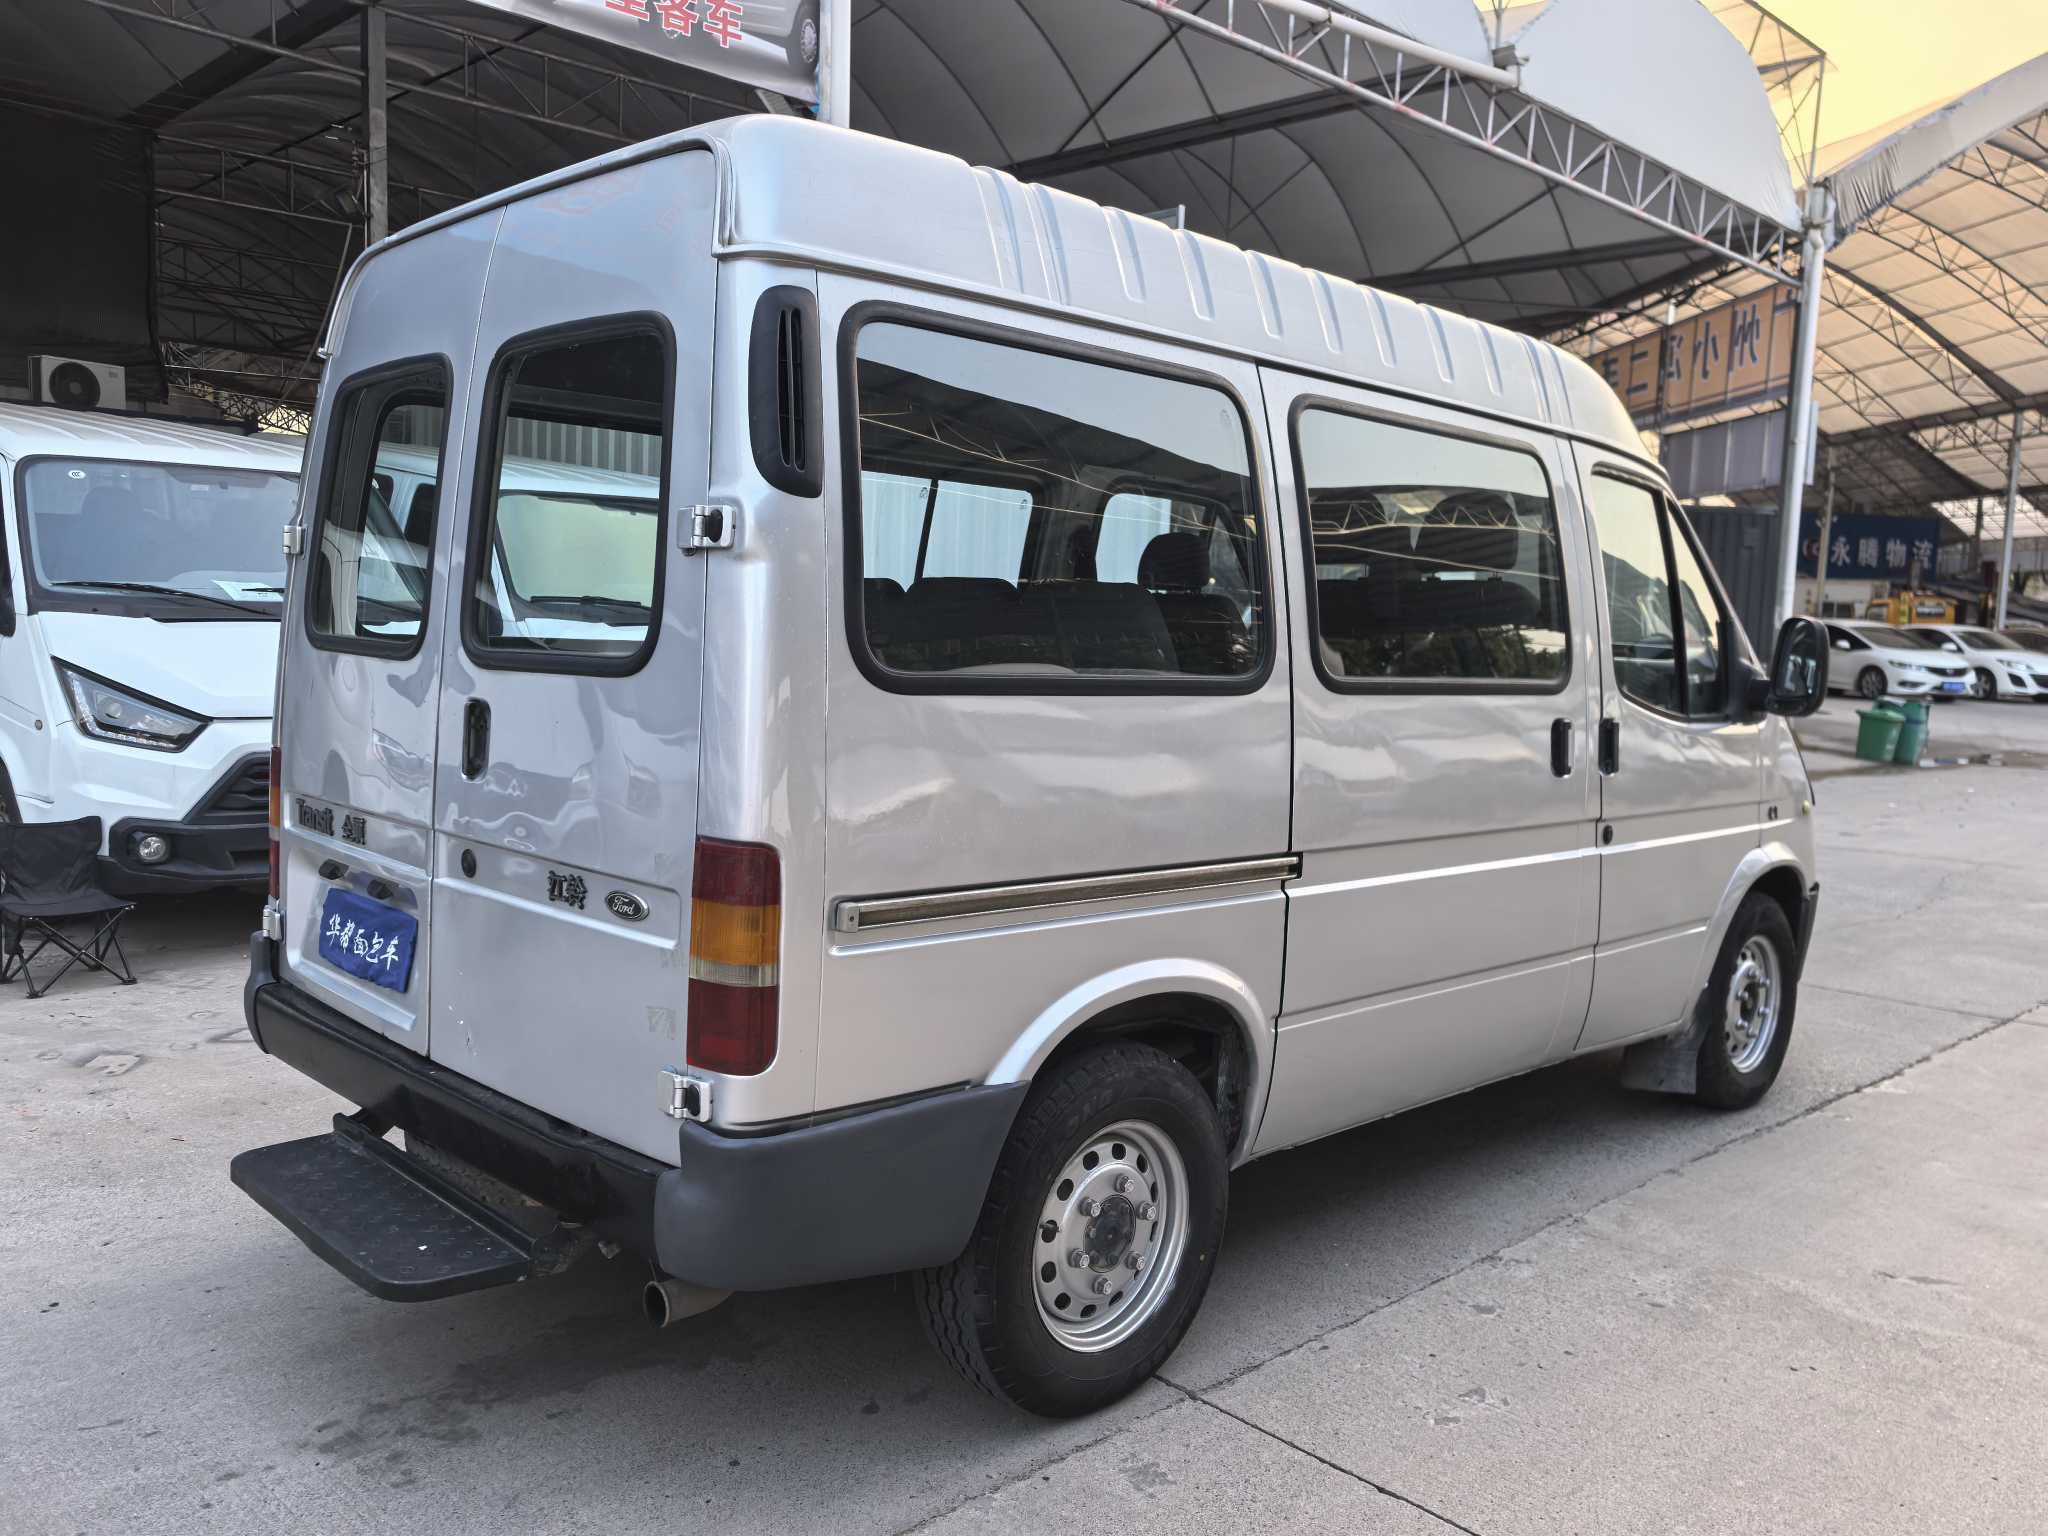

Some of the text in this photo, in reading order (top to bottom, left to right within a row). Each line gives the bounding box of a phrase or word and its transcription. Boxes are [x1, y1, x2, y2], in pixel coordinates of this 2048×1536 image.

[296, 797, 367, 846] Transit 全顺
[546, 869, 588, 910] 江铃
